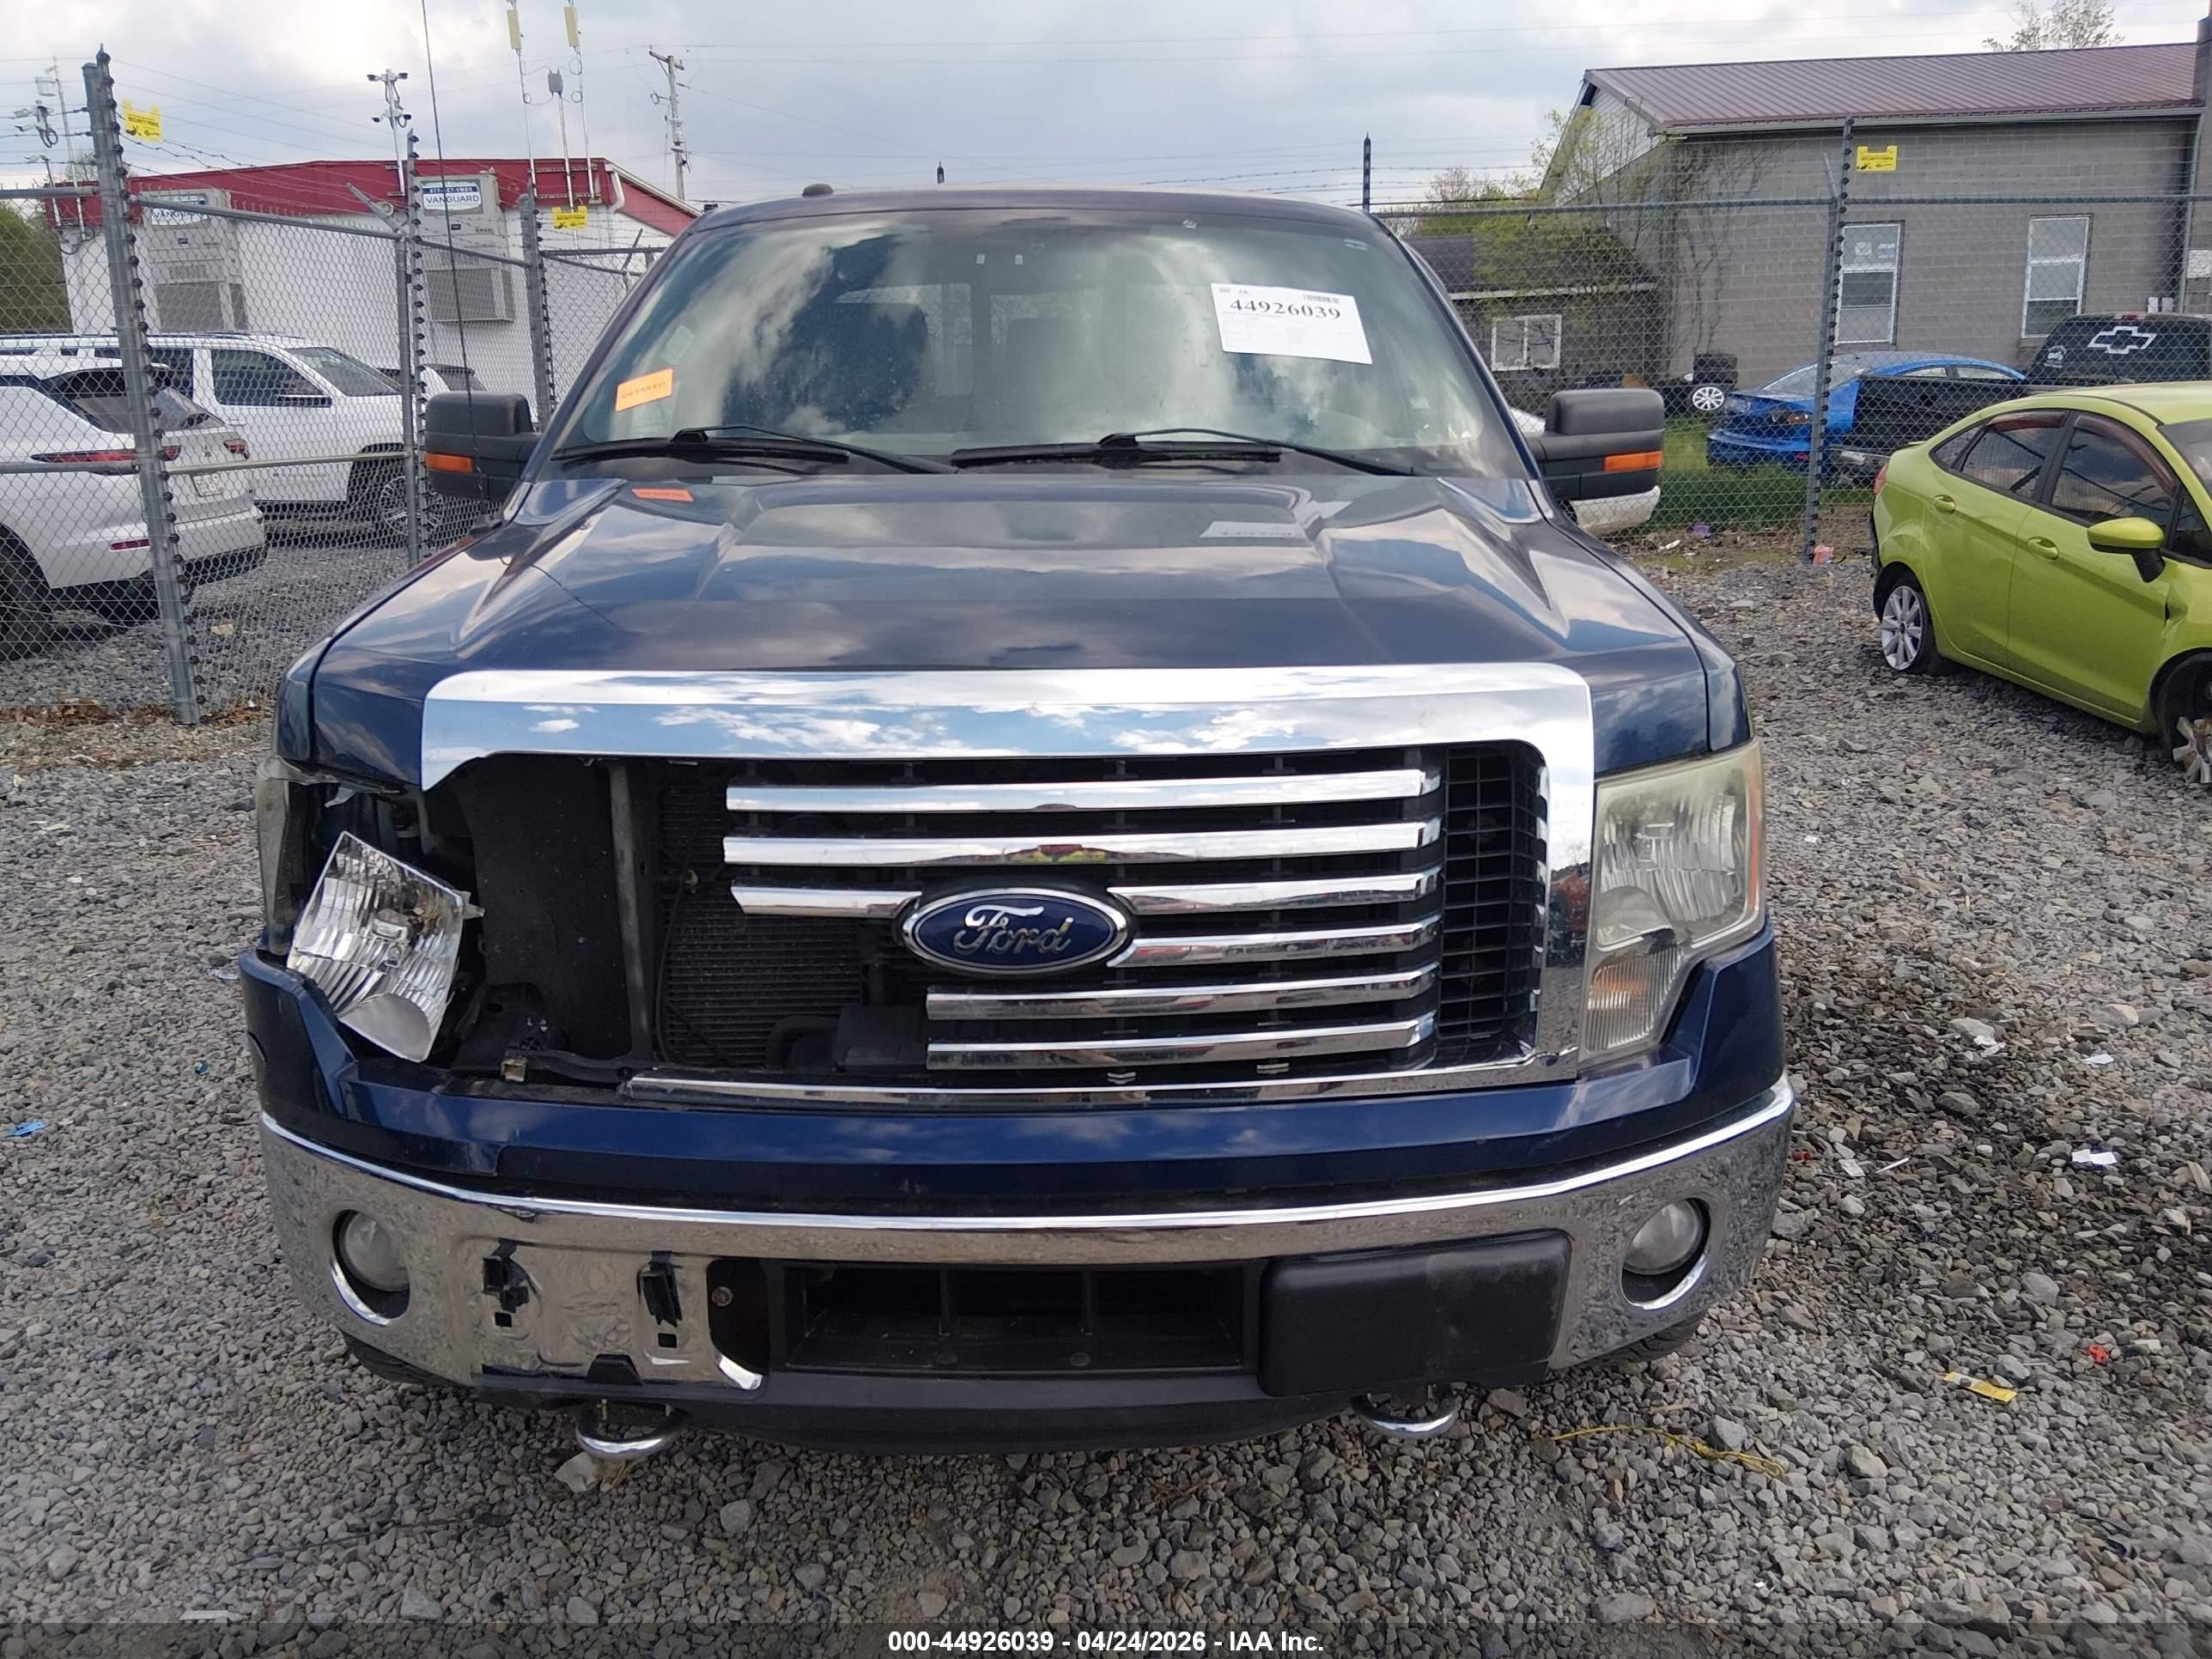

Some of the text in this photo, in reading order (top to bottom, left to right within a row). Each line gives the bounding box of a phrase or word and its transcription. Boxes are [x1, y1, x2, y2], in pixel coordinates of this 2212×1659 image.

[425, 195, 480, 204] VANGUARD
[1229, 298, 1341, 320] 44926039
[953, 904, 1074, 955] Ford
